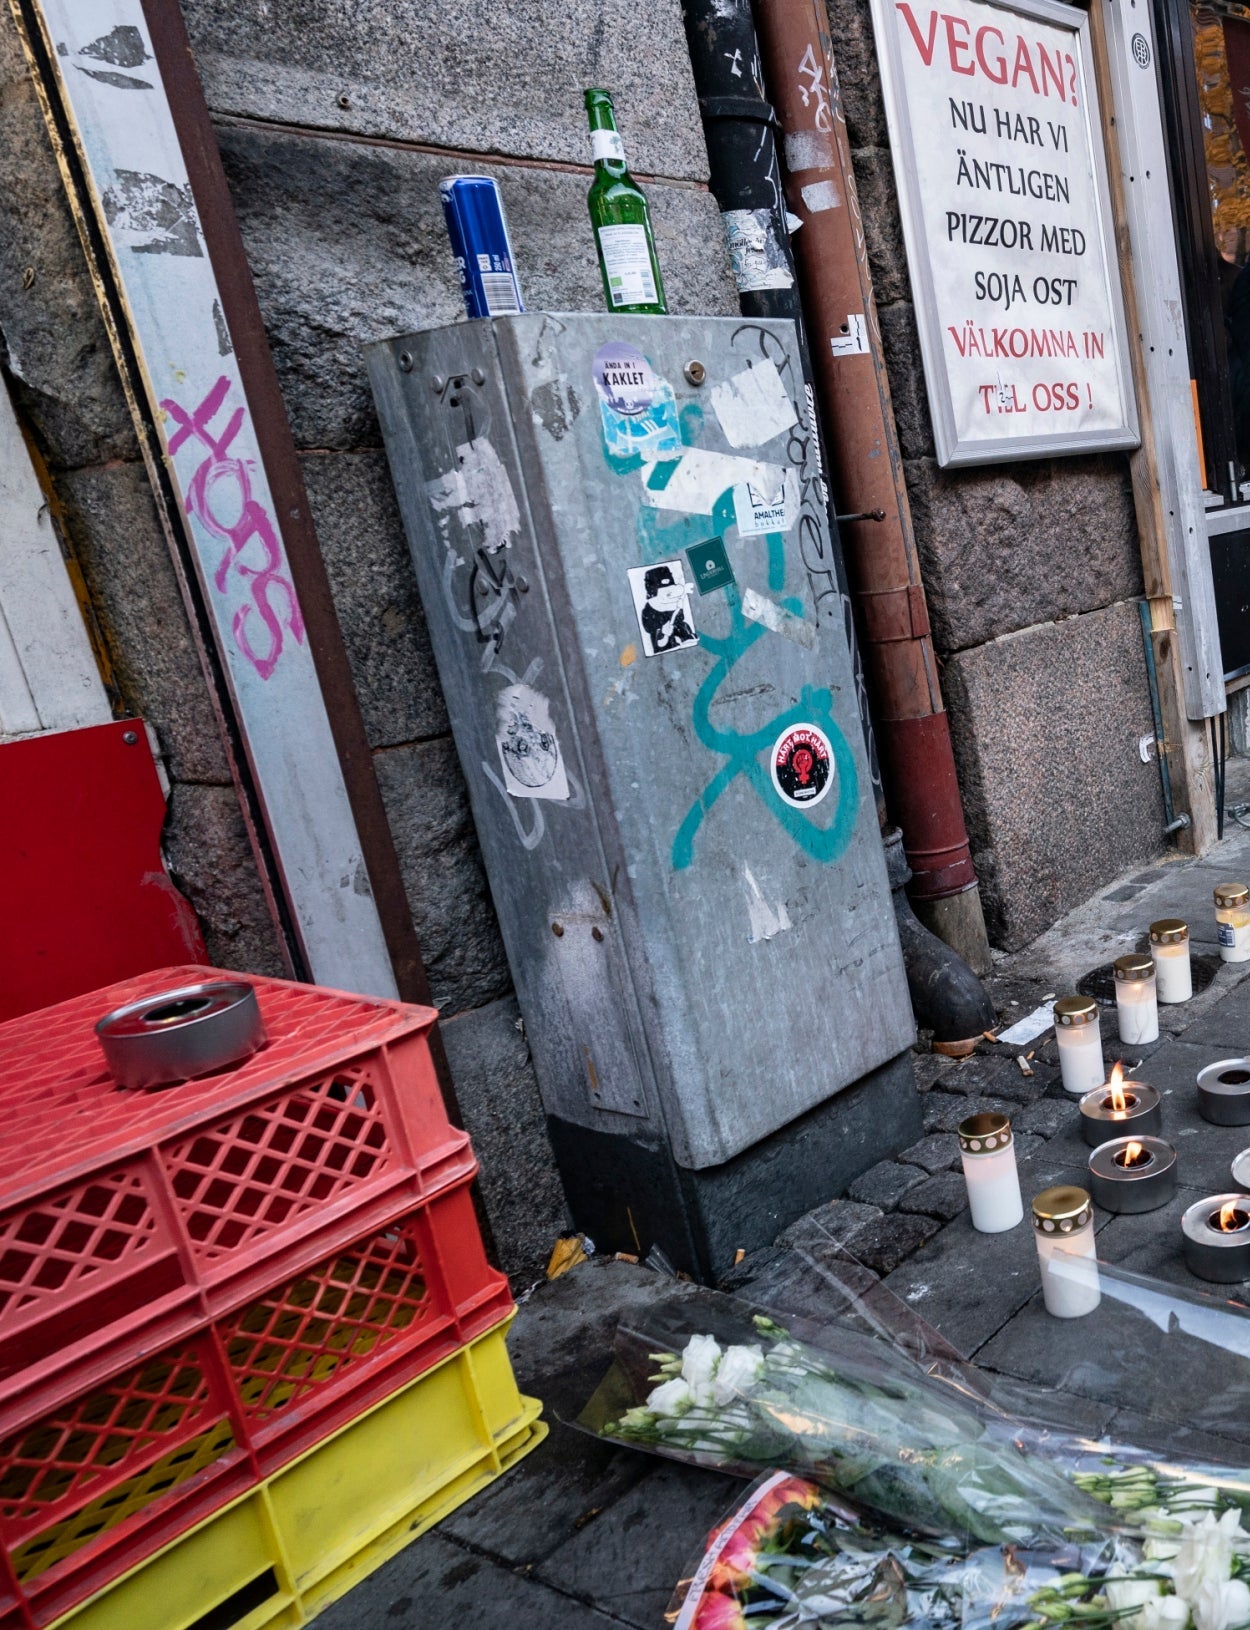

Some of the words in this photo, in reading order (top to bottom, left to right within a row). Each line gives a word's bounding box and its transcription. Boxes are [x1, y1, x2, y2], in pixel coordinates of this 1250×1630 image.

[896, 3, 1078, 107] VEGAN?
[949, 97, 987, 135] NU
[994, 108, 1044, 147] HAR
[1047, 121, 1068, 152] VI
[956, 148, 1070, 204] ÄNTLIGEN
[946, 211, 1033, 251] PIZZOR
[1041, 224, 1086, 256] MED
[974, 271, 1027, 311] SOJA
[1032, 277, 1077, 306] OST
[947, 319, 1079, 359] VÄLKOMNA
[1082, 331, 1105, 360] IN
[602, 372, 644, 386] KAKLET
[605, 361, 621, 369] ÄNDA
[1032, 382, 1080, 412] OSS
[793, 731, 812, 745] MOT
